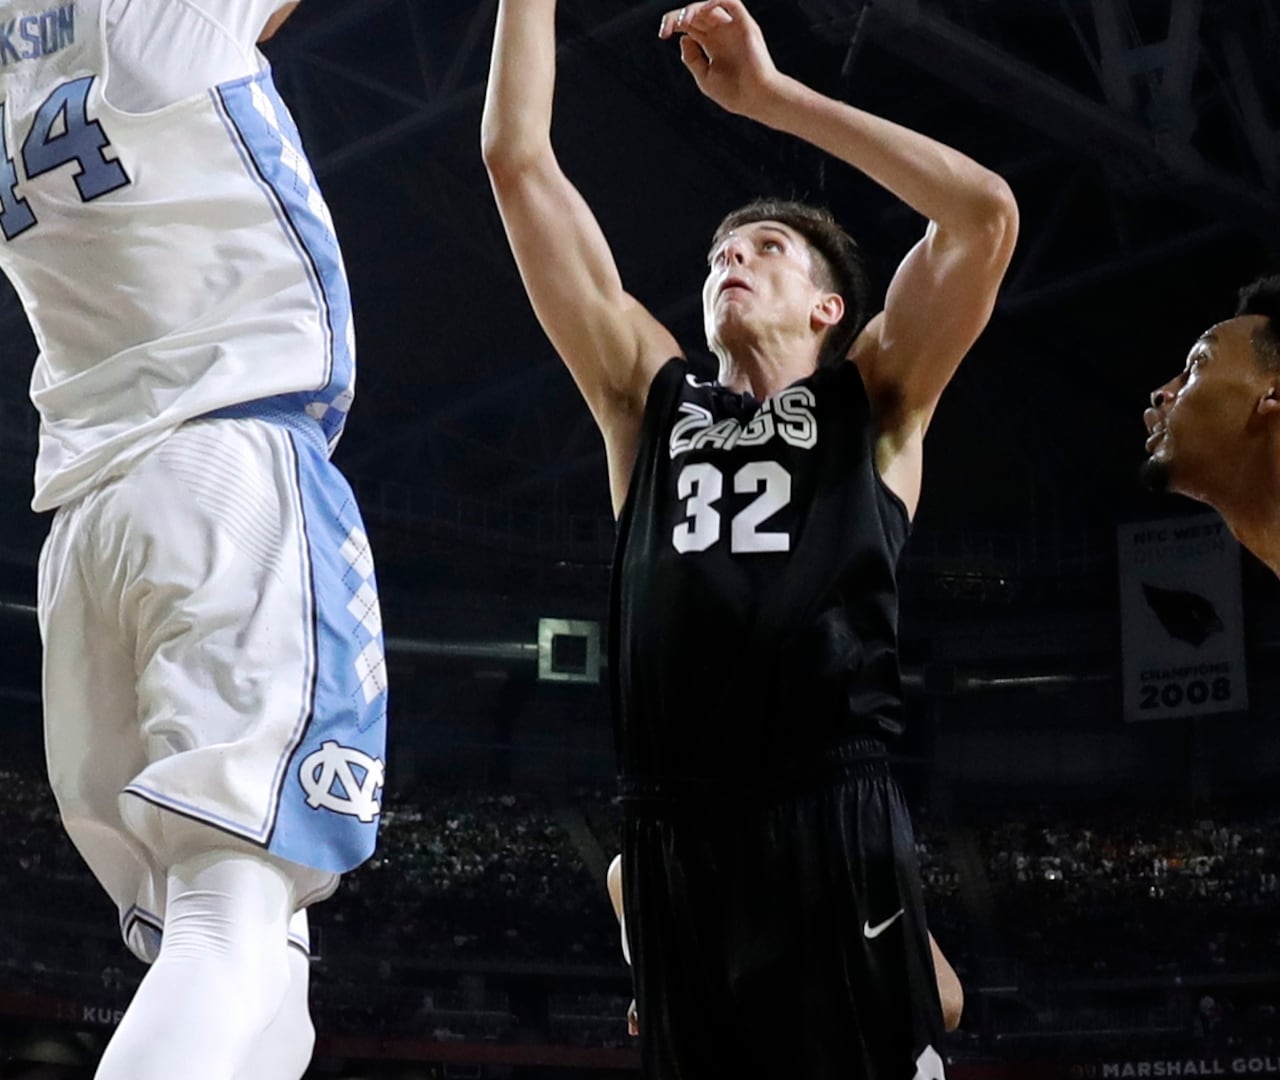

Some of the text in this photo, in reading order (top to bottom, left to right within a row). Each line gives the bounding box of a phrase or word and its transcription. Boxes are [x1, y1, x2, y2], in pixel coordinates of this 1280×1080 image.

[672, 460, 791, 554] 32
[1139, 676, 1231, 710] 2008
[1103, 1059, 1224, 1079] MARSHALL
